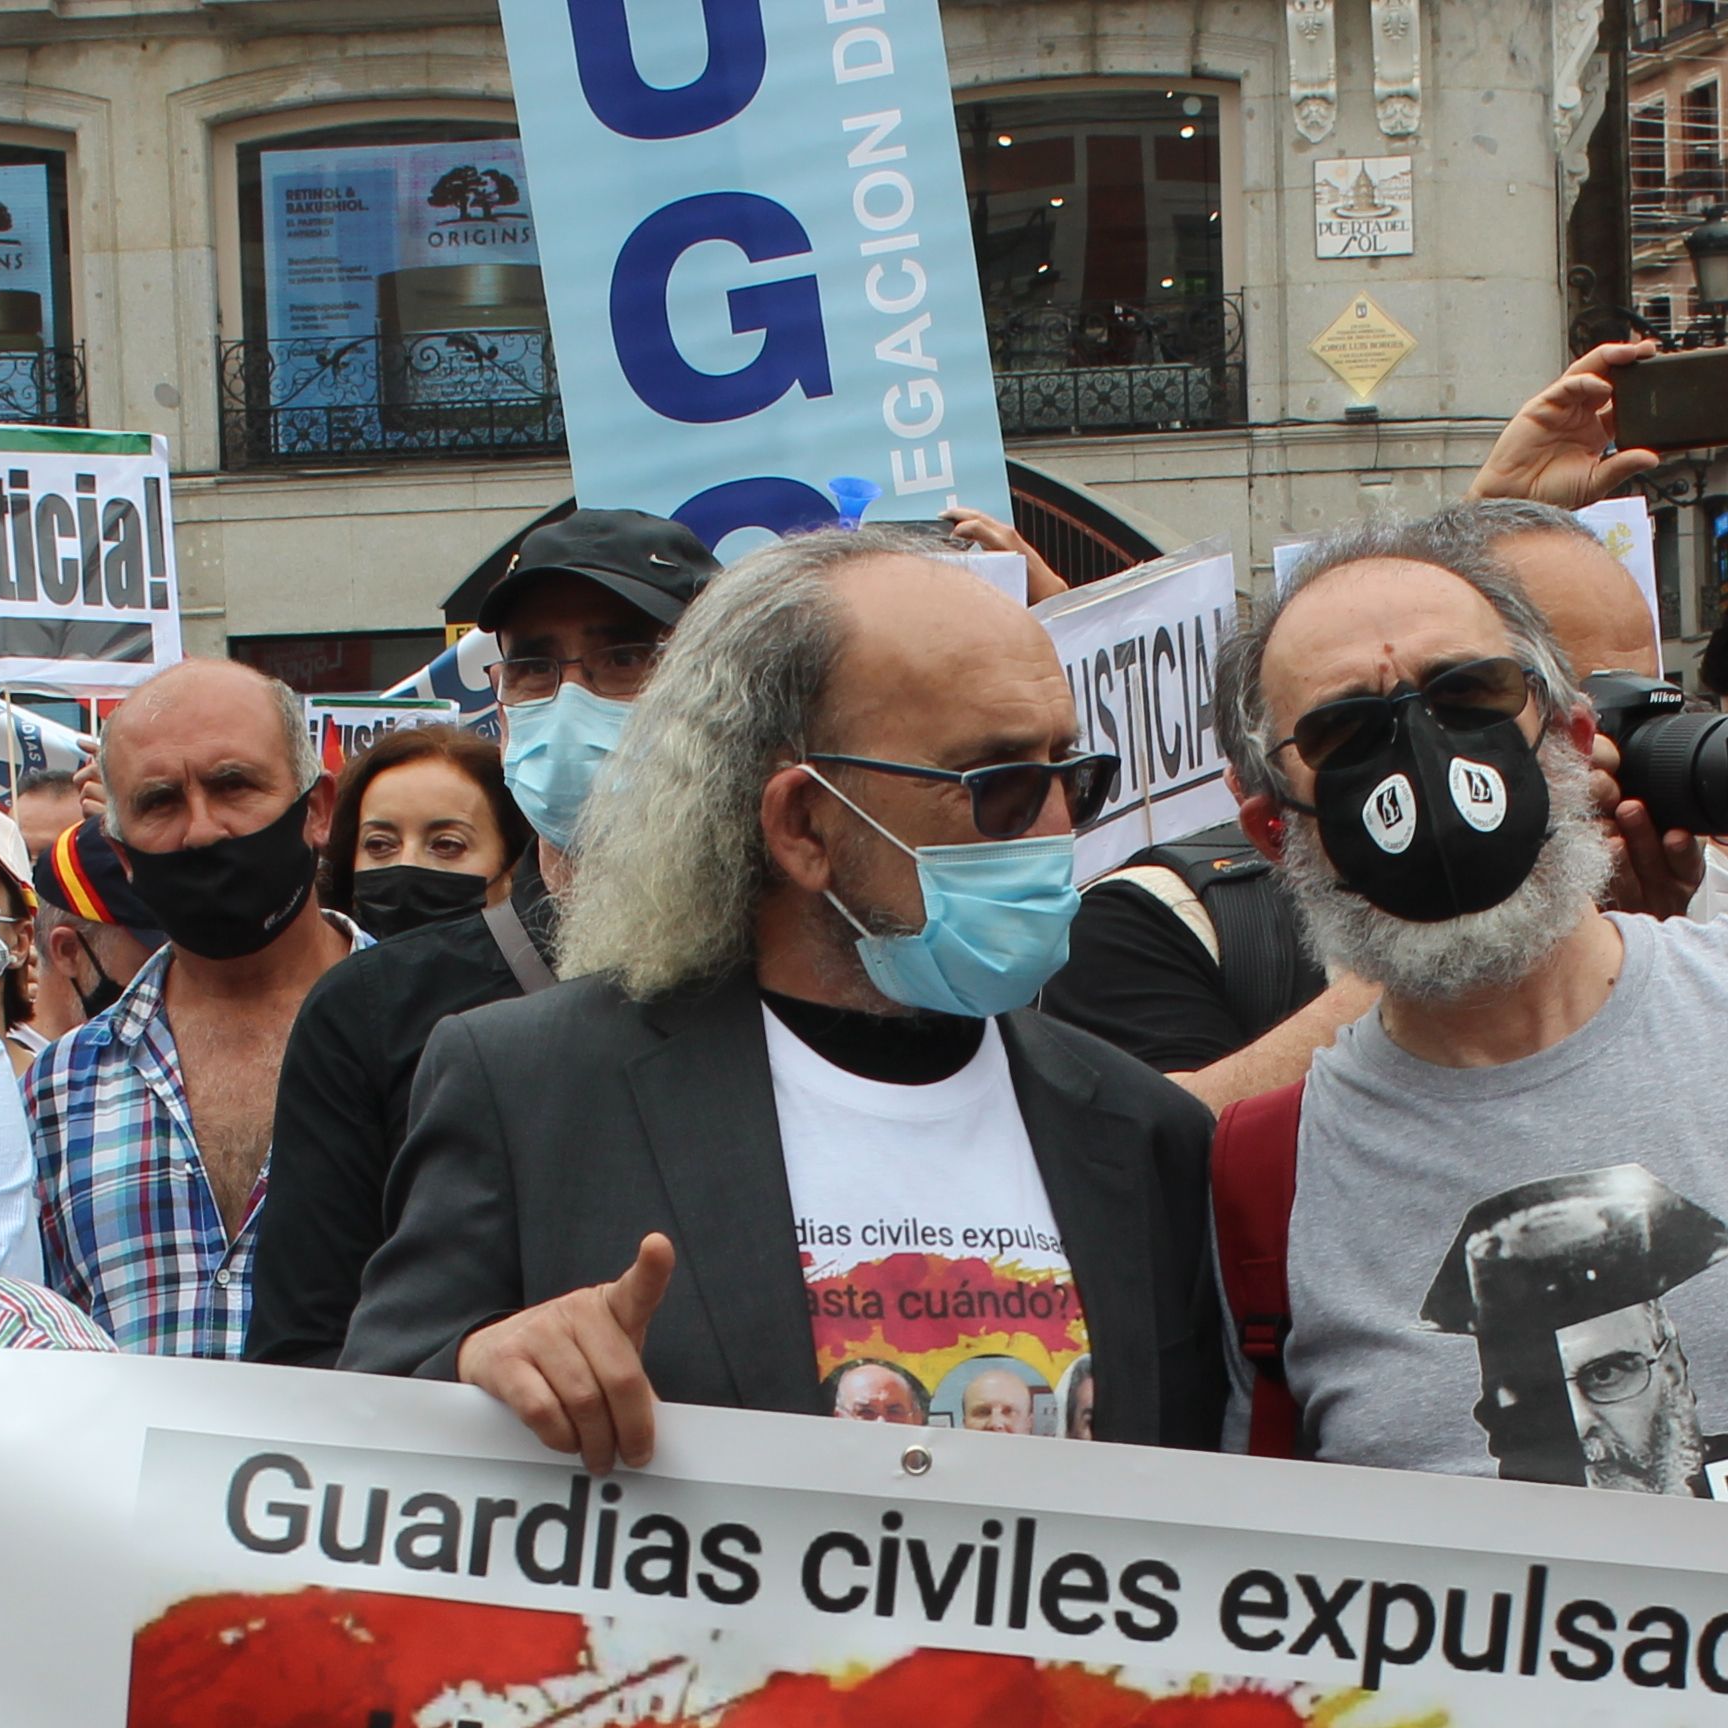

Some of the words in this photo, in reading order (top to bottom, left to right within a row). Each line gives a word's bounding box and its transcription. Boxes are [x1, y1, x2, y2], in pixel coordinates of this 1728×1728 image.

[428, 227, 530, 248] ORIGINS
[1318, 220, 1383, 237] PUERTA
[1337, 234, 1388, 255] SOL
[1650, 691, 1682, 703] Nikon
[861, 1218, 954, 1247] civiles
[224, 1450, 764, 1605] Guardias
[799, 1508, 1184, 1642] civiles
